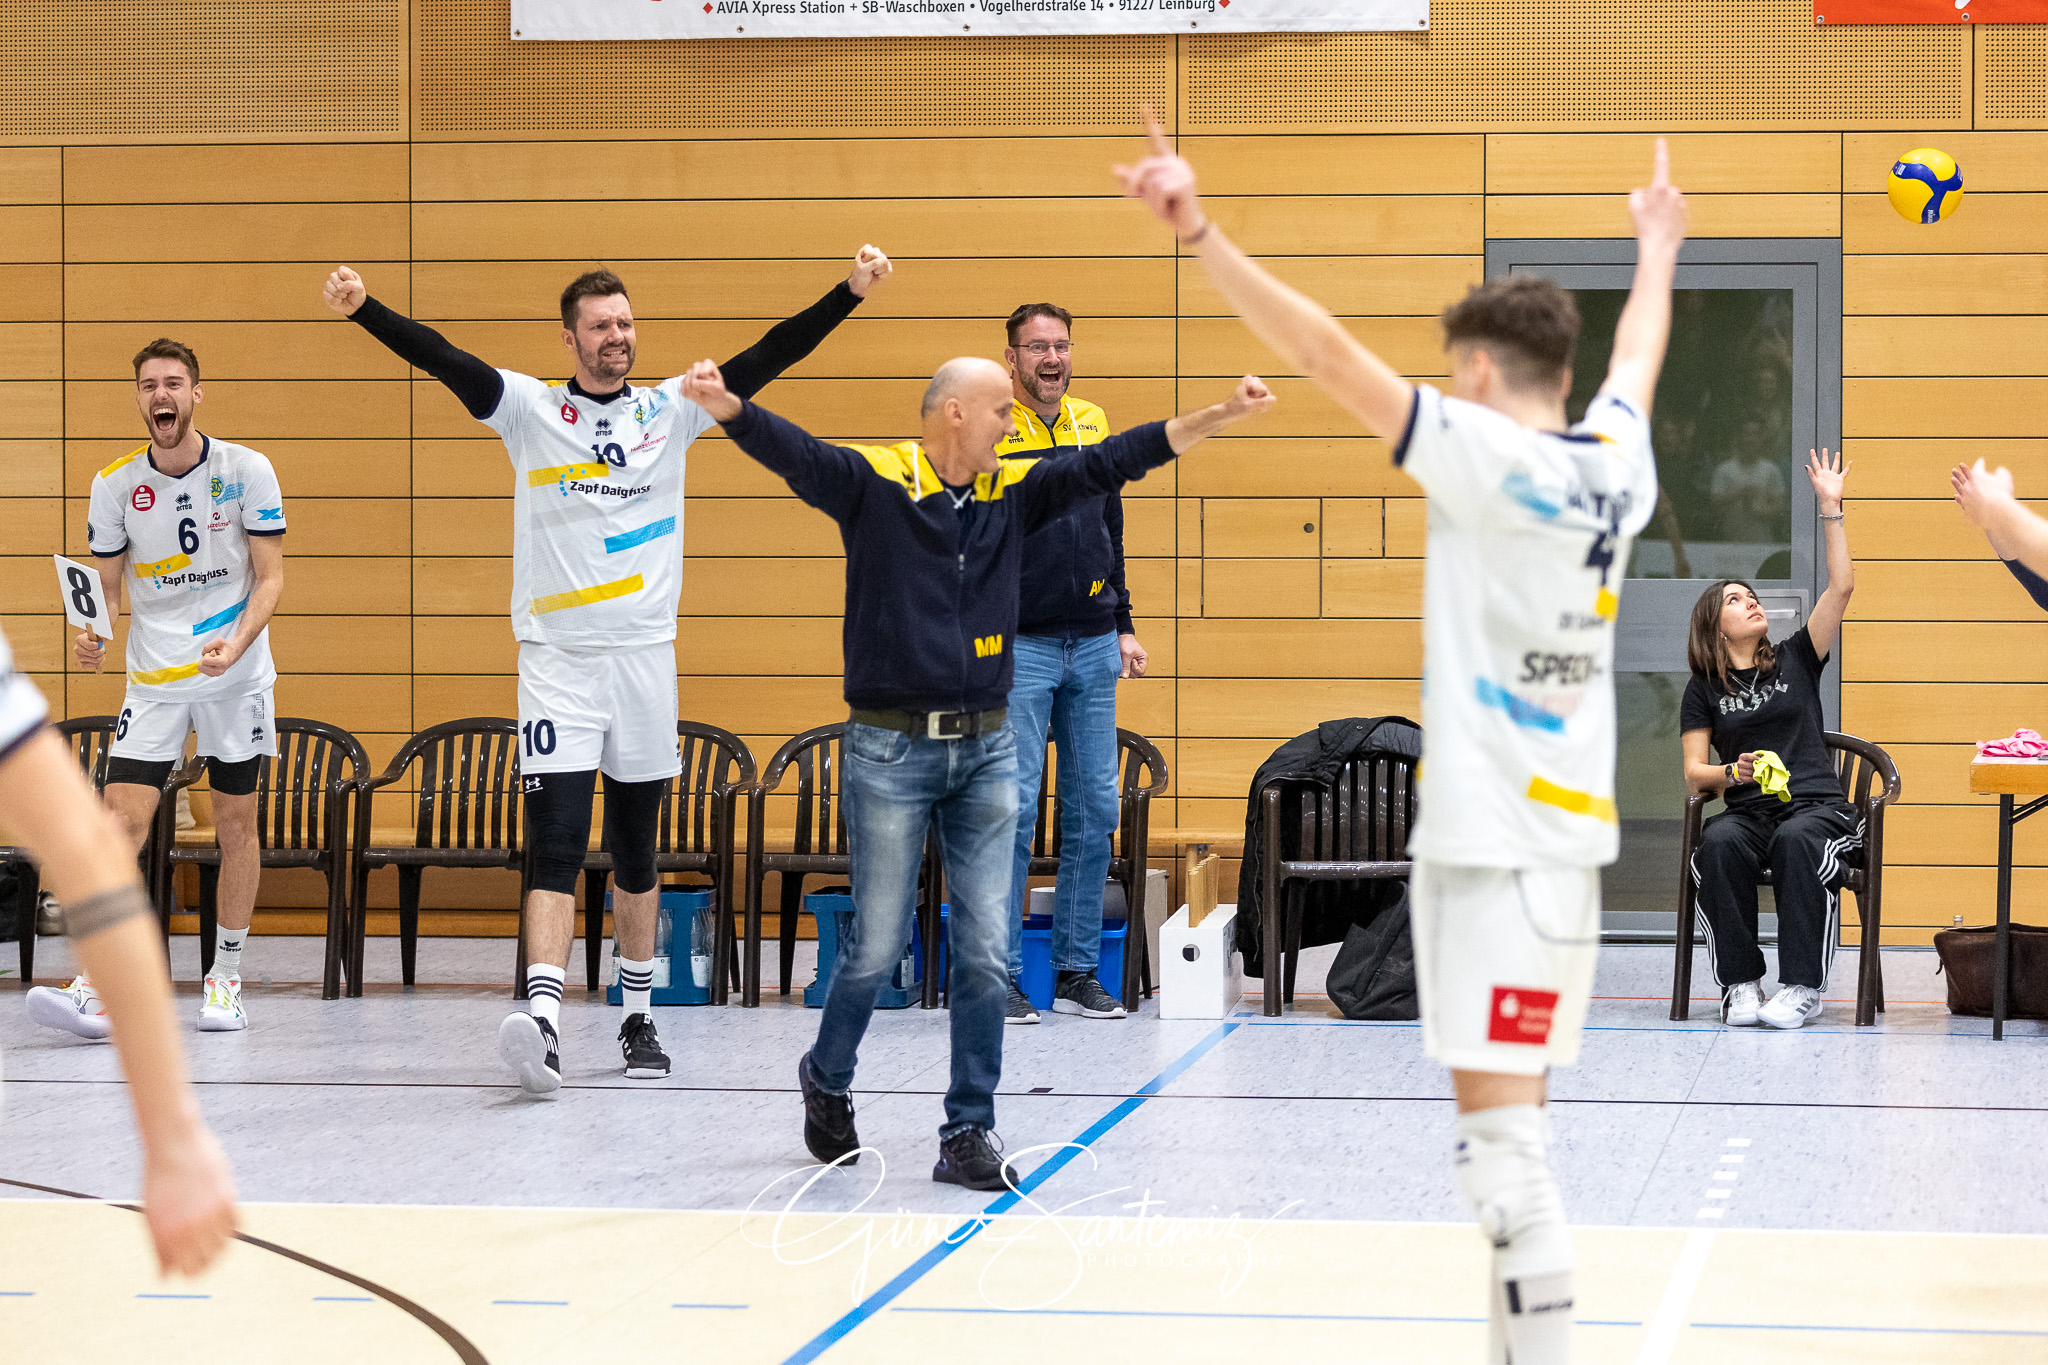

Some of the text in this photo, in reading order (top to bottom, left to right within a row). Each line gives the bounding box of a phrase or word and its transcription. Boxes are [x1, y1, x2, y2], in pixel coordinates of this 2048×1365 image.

[716, 0, 749, 14] AVIA
[752, 0, 796, 17] Xpress
[799, 0, 845, 14] Station
[849, 3, 858, 11] +
[862, 0, 965, 14] SB-Waschboxen
[979, 0, 1086, 15] Vogelherdstraße
[1090, 0, 1104, 12] 14
[1158, 0, 1215, 12] Leinburg
[590, 442, 627, 468] 10
[569, 480, 600, 495] Zapf
[600, 484, 652, 499] Daigfuss
[178, 517, 200, 555] 6
[66, 565, 97, 619] 8
[161, 573, 186, 587] Zapf
[115, 707, 132, 742] 6
[522, 718, 557, 758] 10
